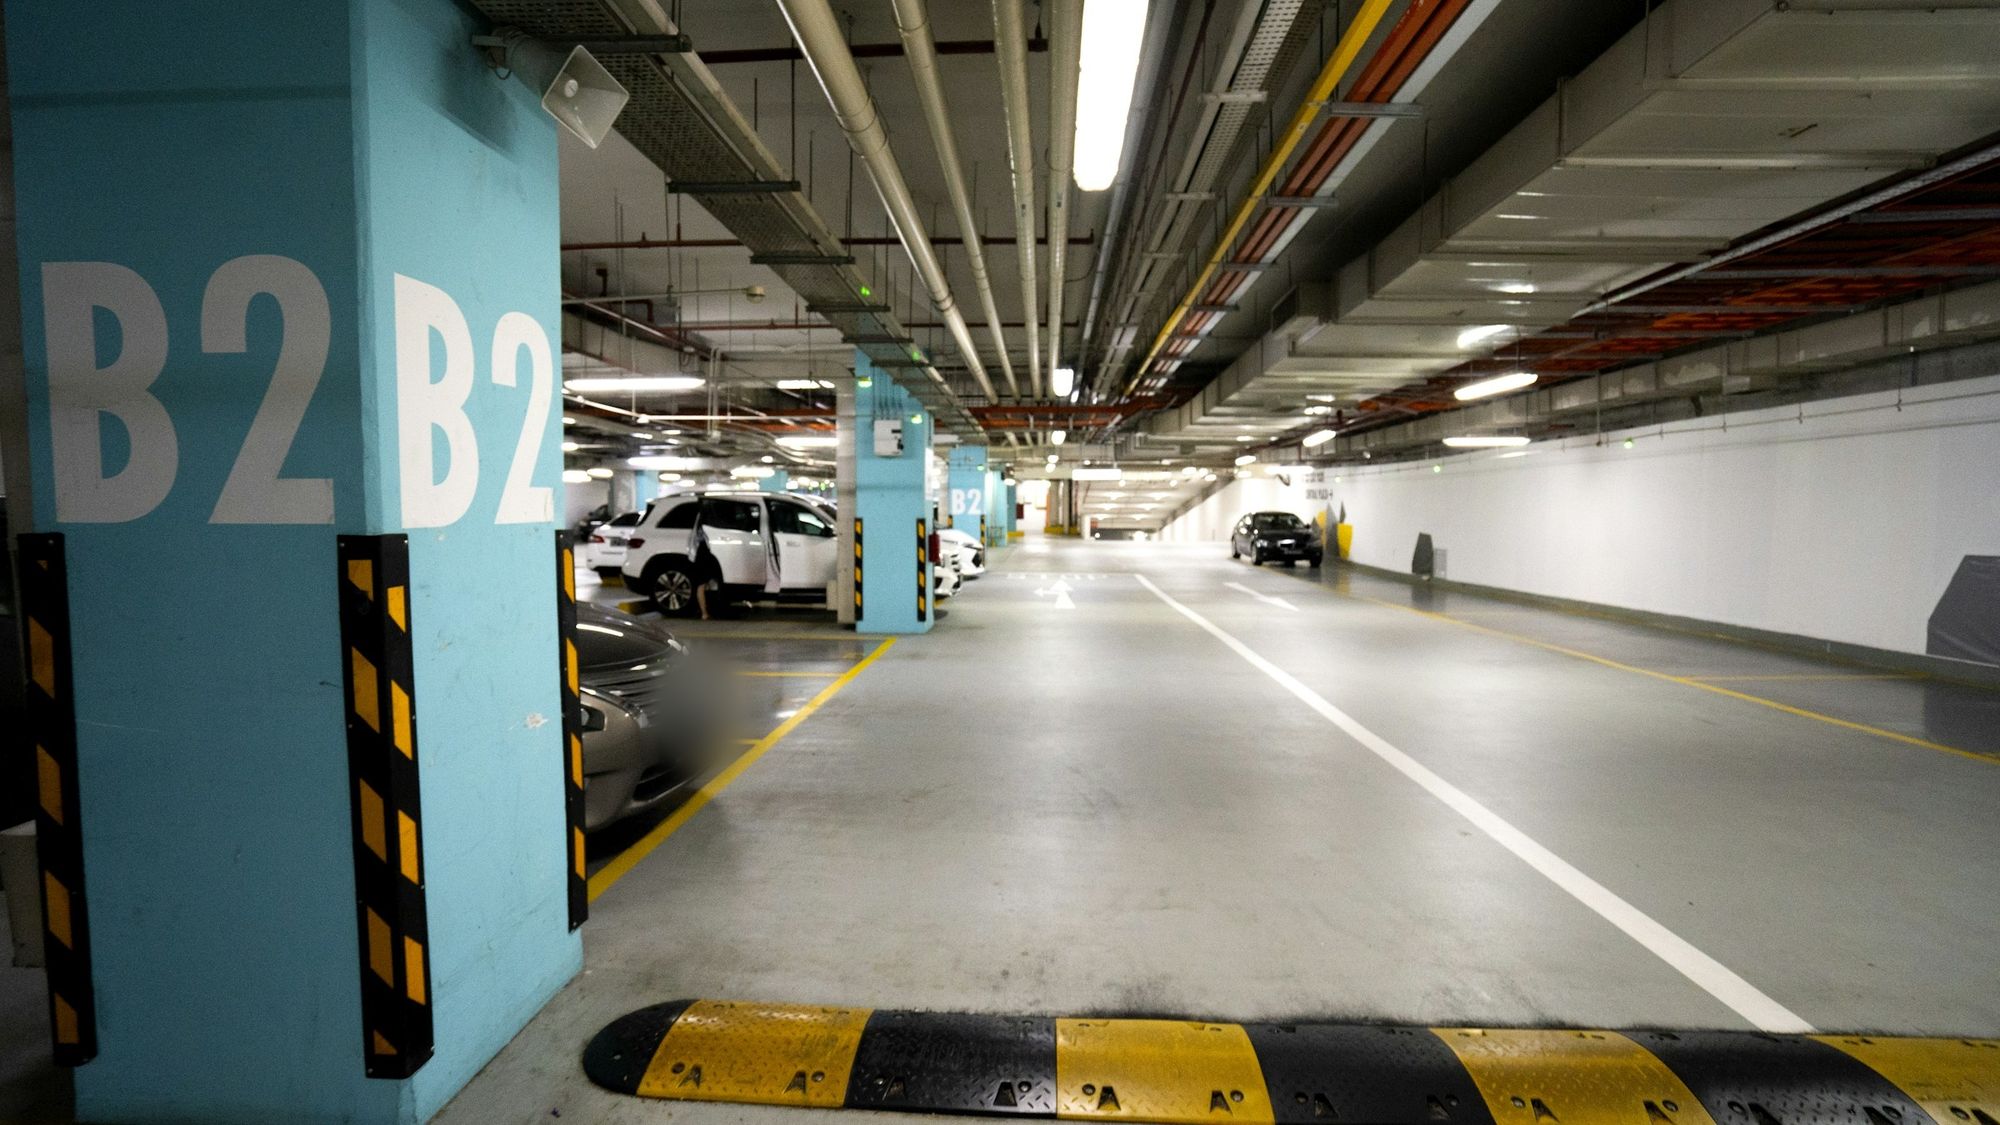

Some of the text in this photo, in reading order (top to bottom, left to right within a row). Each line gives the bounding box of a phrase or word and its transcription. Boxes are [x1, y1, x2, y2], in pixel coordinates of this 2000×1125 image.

[41, 254, 335, 525] B2
[393, 273, 554, 529] B2
[951, 488, 982, 515] B2
